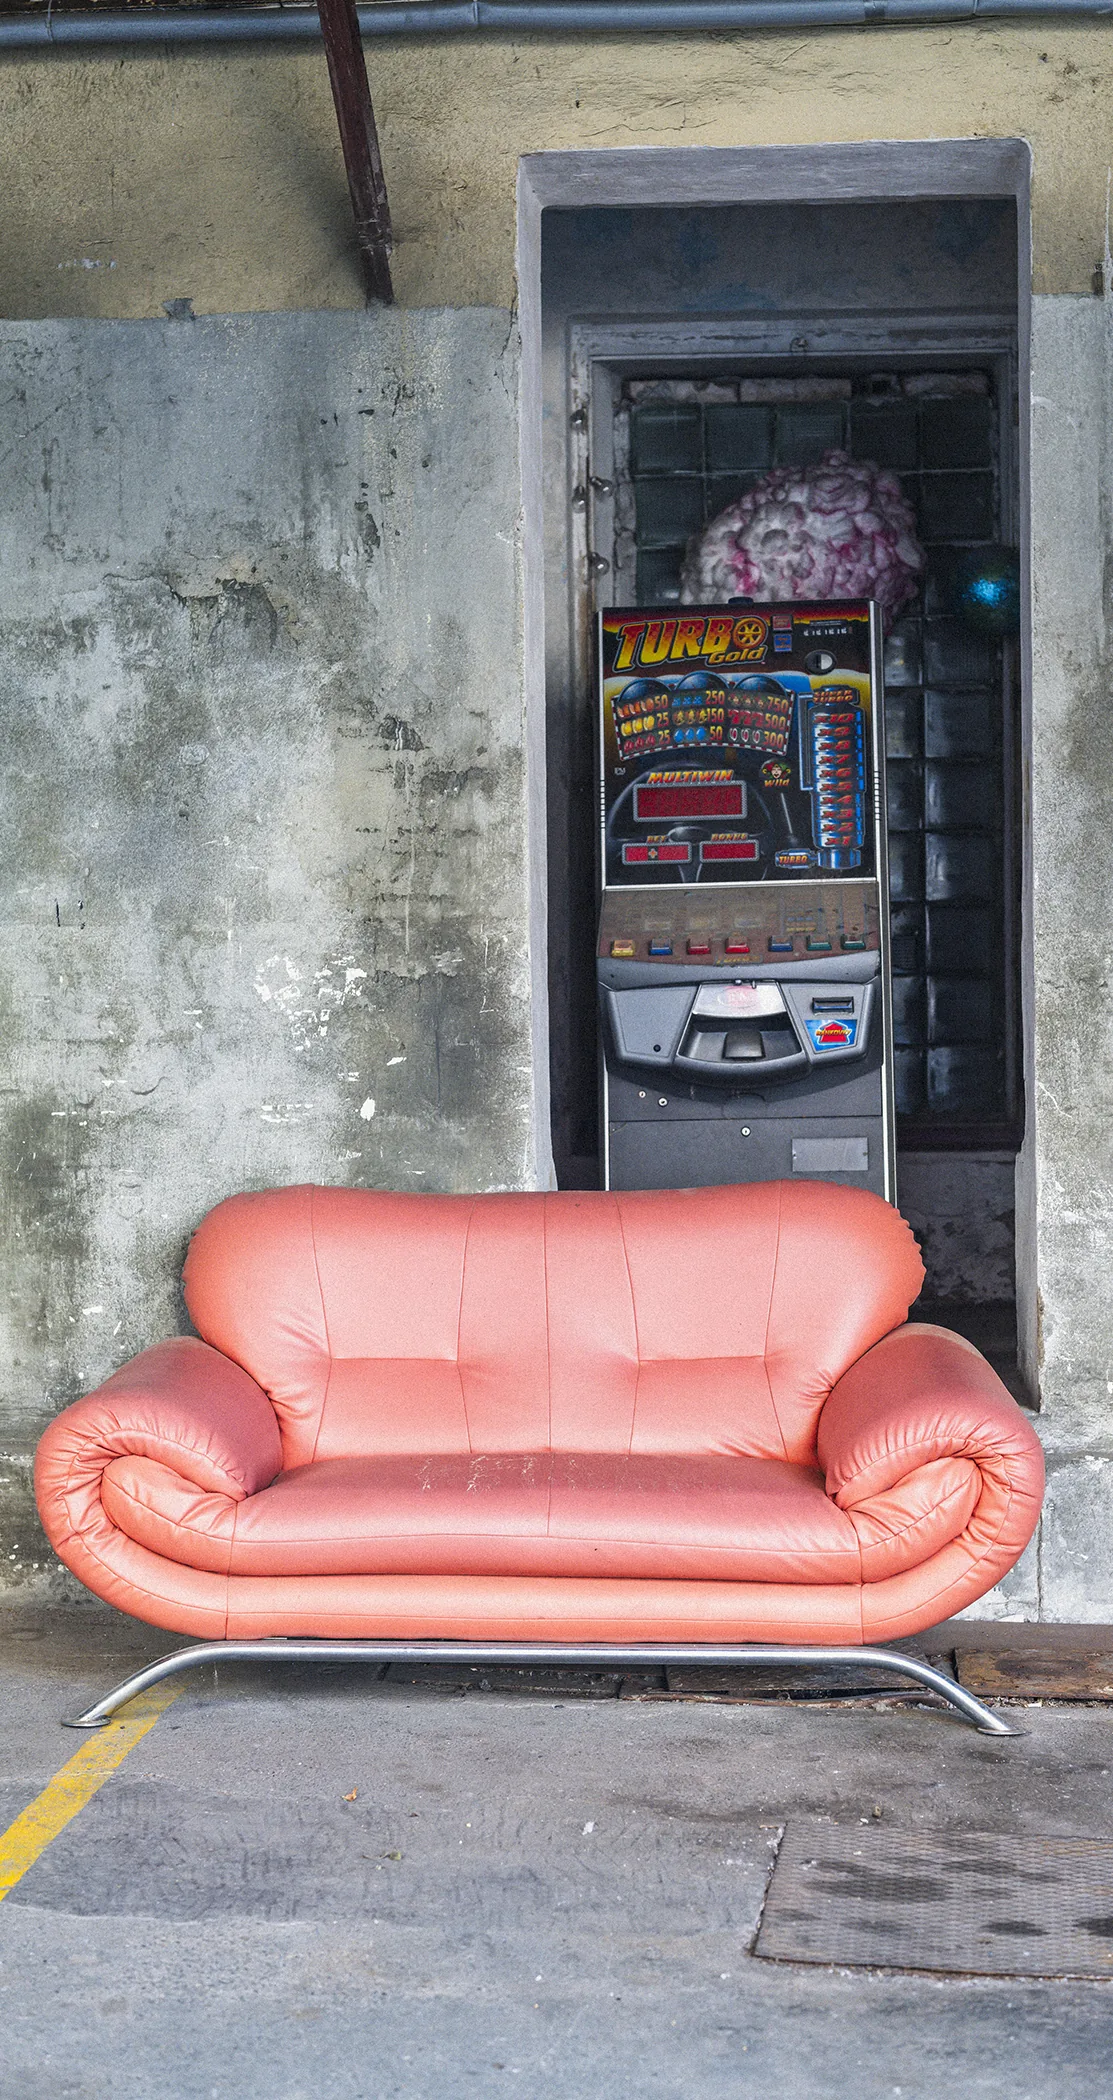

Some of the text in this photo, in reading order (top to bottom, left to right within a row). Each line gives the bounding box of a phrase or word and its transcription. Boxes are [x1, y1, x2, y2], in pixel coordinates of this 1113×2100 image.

[615, 617, 766, 670] TURBO
[708, 648, 765, 665] Gold
[654, 690, 789, 714] 50 250 750
[812, 694, 854, 704] TURBO
[657, 712, 669, 728] 25
[706, 708, 725, 723] 150
[765, 713, 787, 731] 500
[658, 726, 785, 749] 25 50 300
[646, 769, 734, 784] MULTIWIN
[646, 835, 668, 843] BET
[711, 833, 748, 842] BONUS
[778, 855, 808, 864] TURBO
